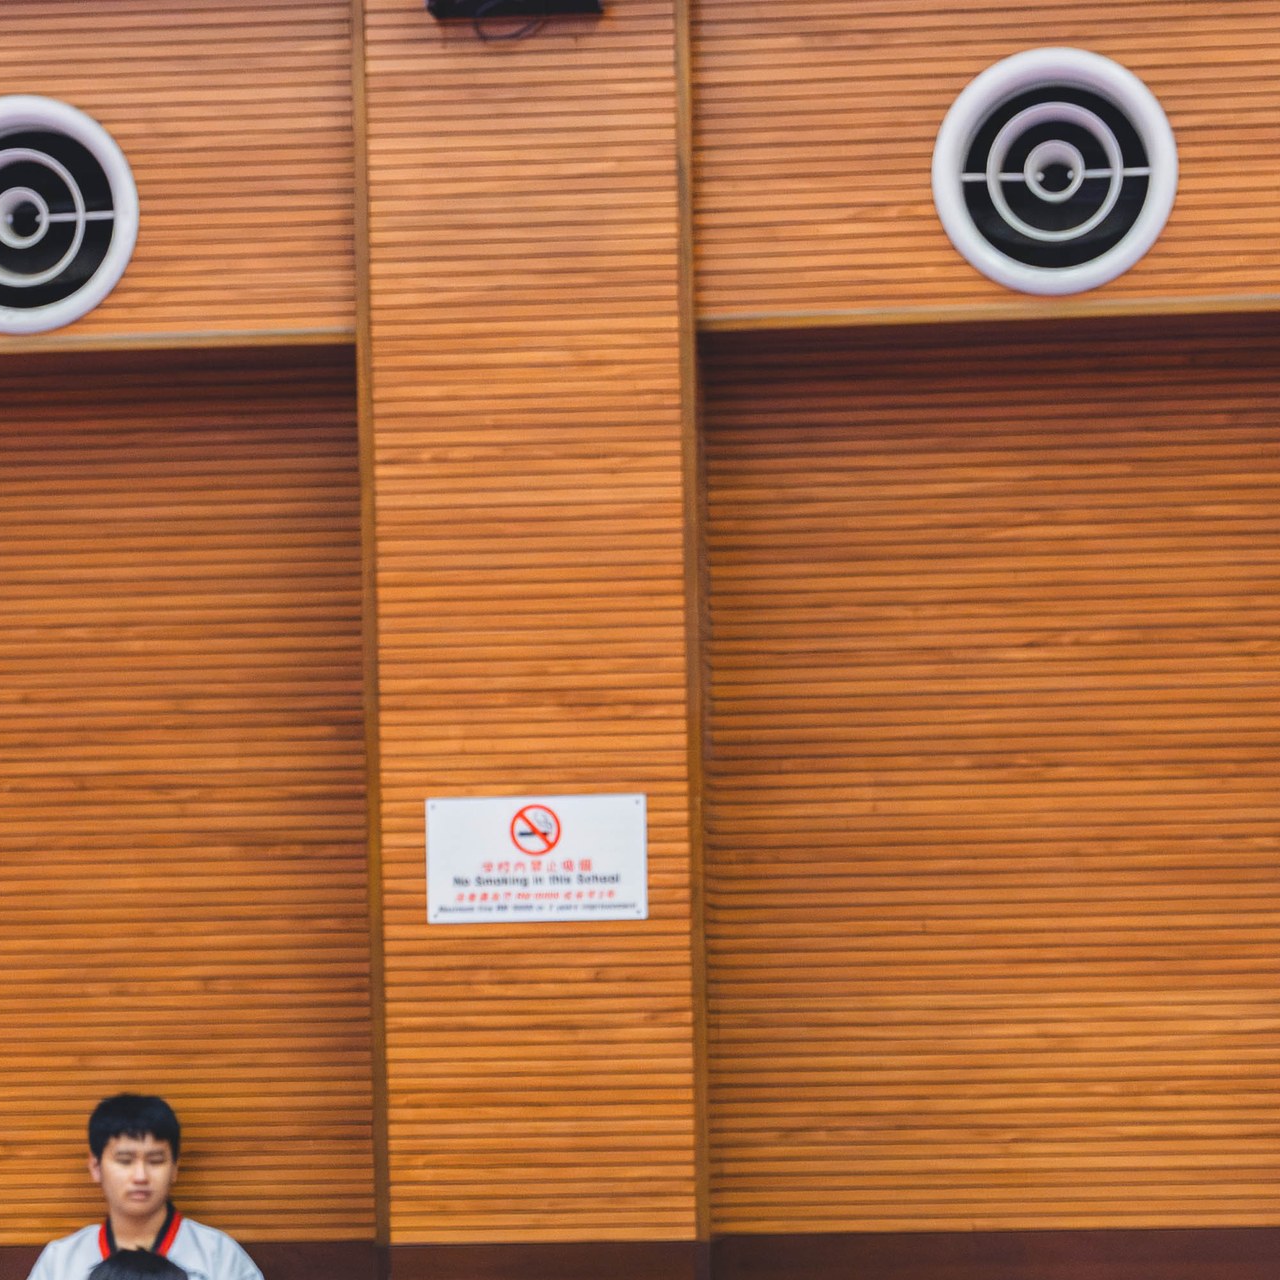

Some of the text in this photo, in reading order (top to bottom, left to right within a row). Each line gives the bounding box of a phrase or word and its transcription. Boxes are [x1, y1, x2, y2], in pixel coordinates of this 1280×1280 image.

[453, 872, 620, 889] No Smoking in this School
